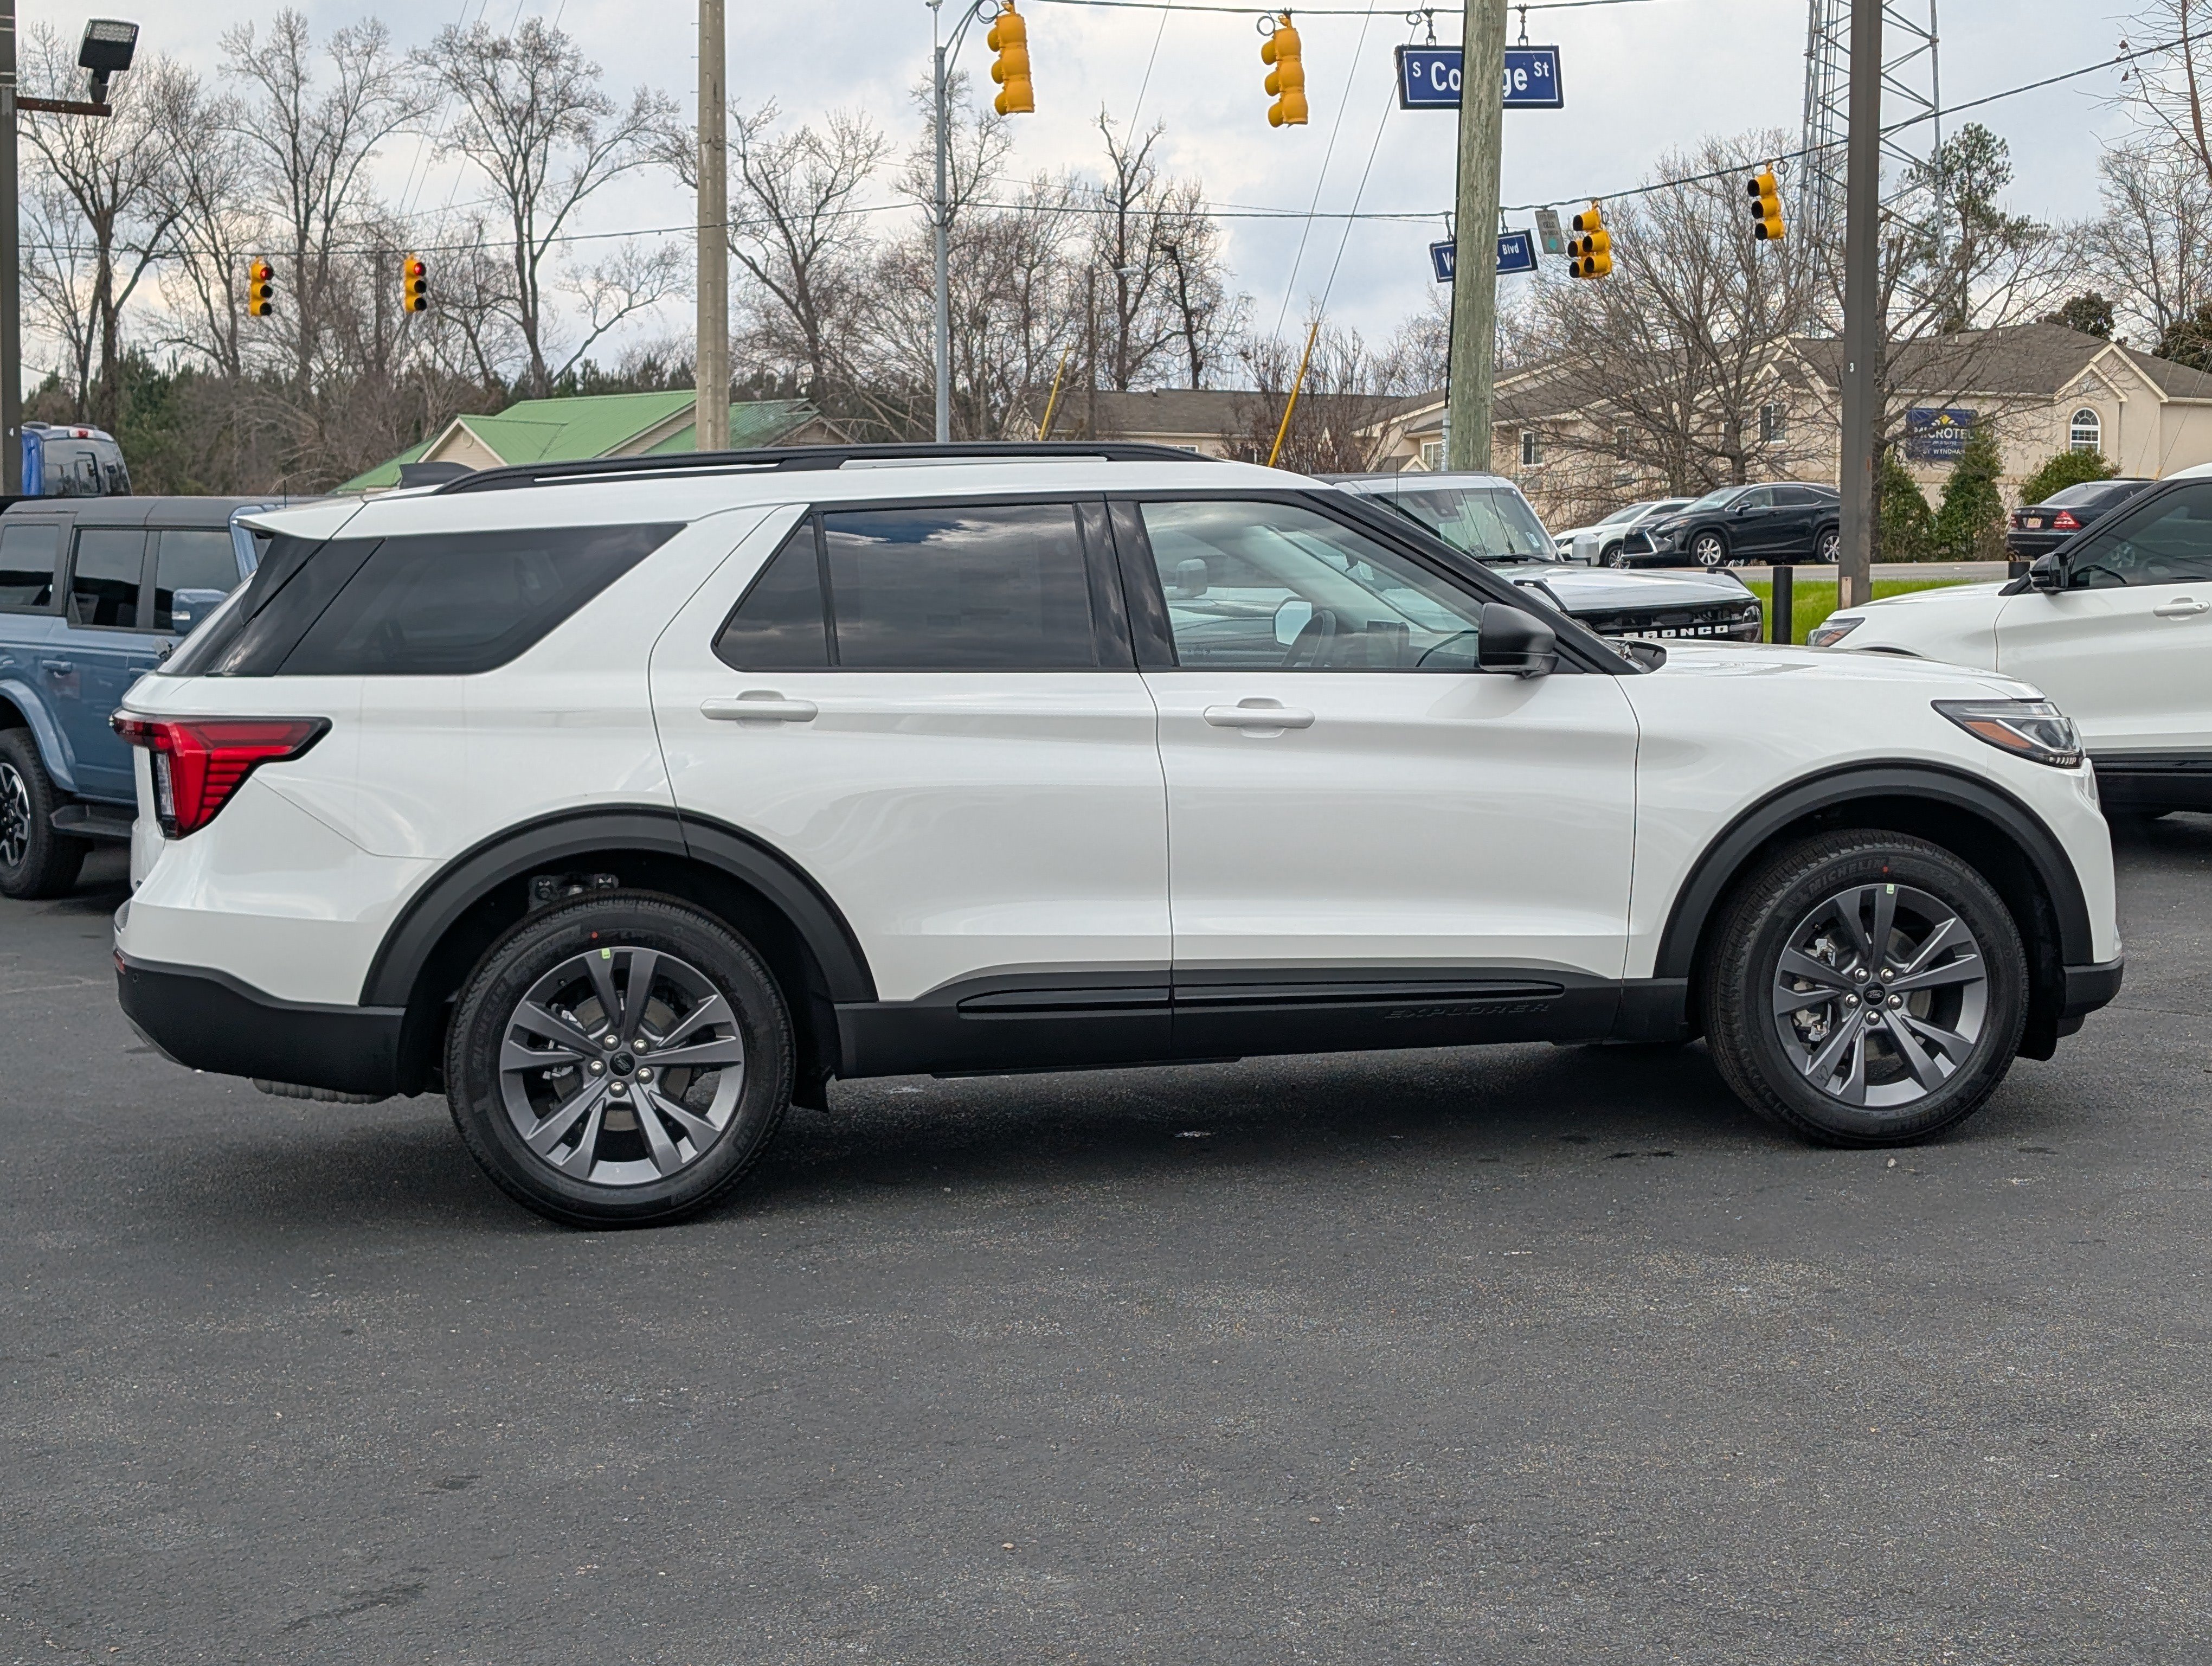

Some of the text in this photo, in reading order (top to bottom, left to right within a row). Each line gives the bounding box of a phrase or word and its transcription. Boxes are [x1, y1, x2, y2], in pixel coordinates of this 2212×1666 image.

[1412, 61, 1549, 98] S Coge St
[1502, 242, 1520, 255] Blvd
[1849, 362, 1854, 372] 3
[1809, 858, 1888, 894] MICHELIN
[1384, 1004, 1549, 1019] EXPLORER
